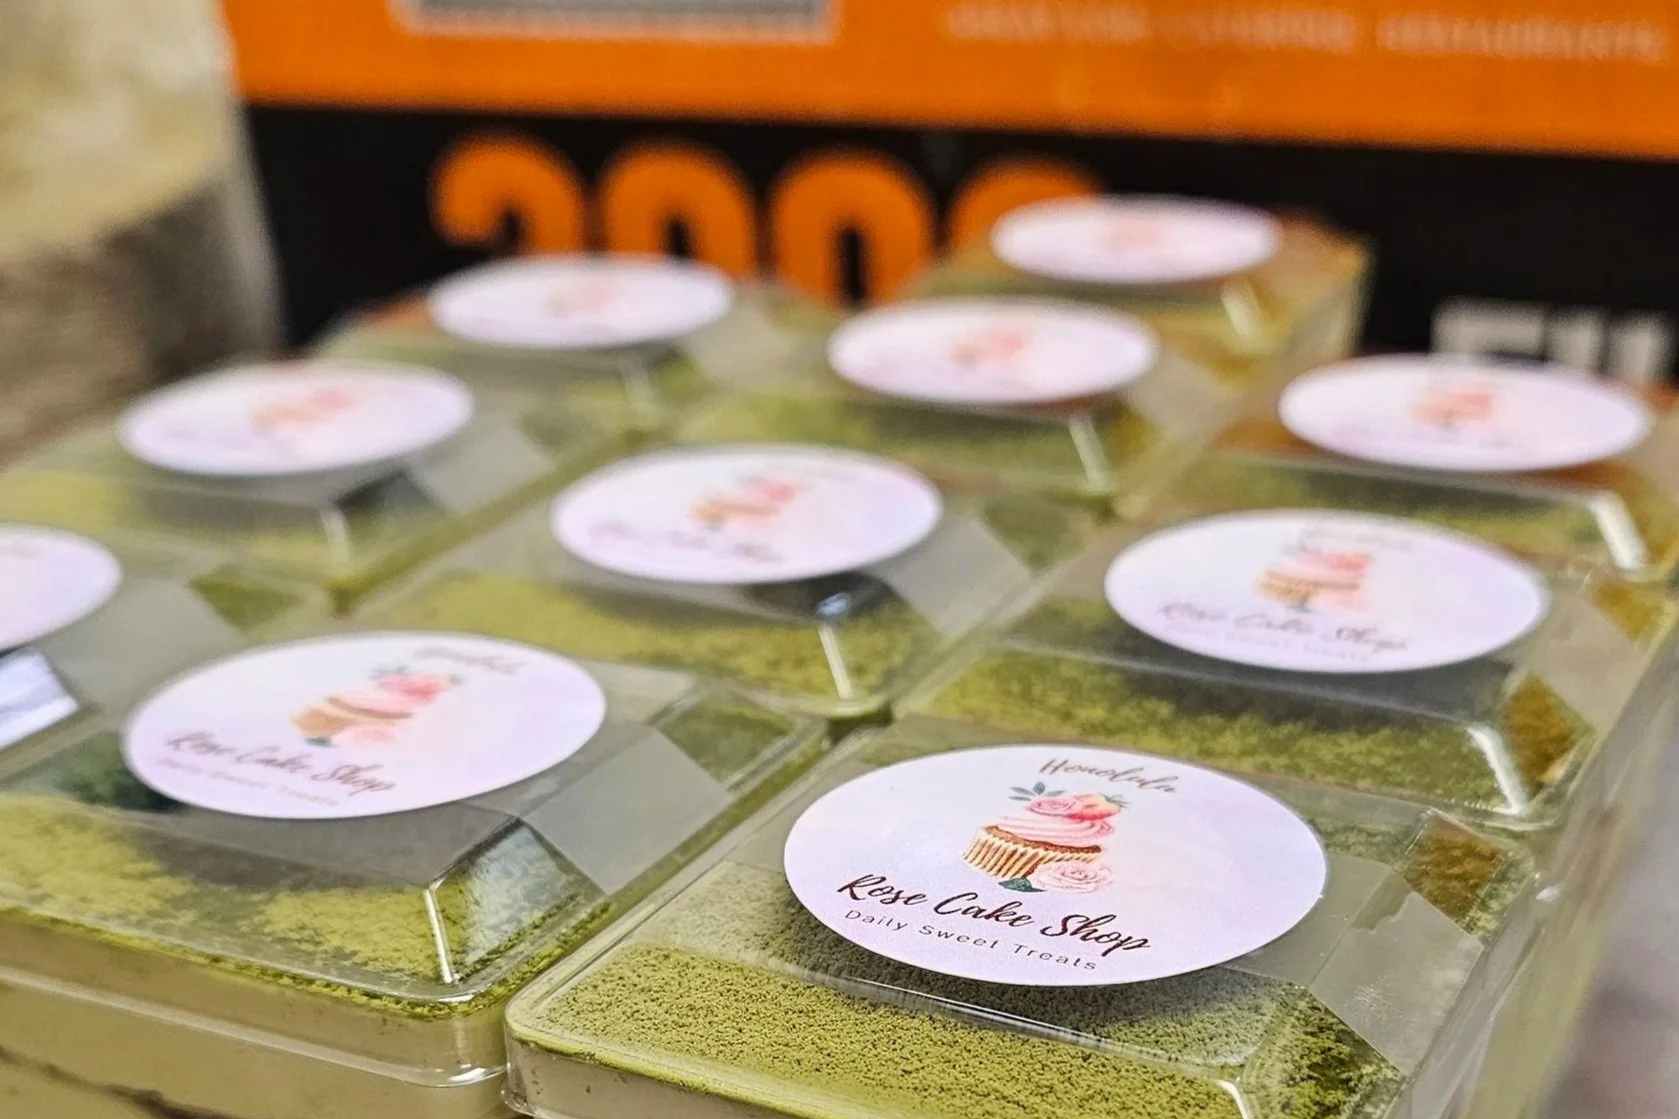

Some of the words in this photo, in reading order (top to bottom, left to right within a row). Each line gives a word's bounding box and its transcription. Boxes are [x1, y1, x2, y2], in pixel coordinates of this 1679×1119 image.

[836, 873, 928, 906] Rose
[933, 891, 1035, 928] Cake
[1040, 913, 1151, 958] Shop
[844, 909, 909, 932] Daily
[918, 924, 999, 950] Sweet
[1013, 943, 1097, 971] Treats
